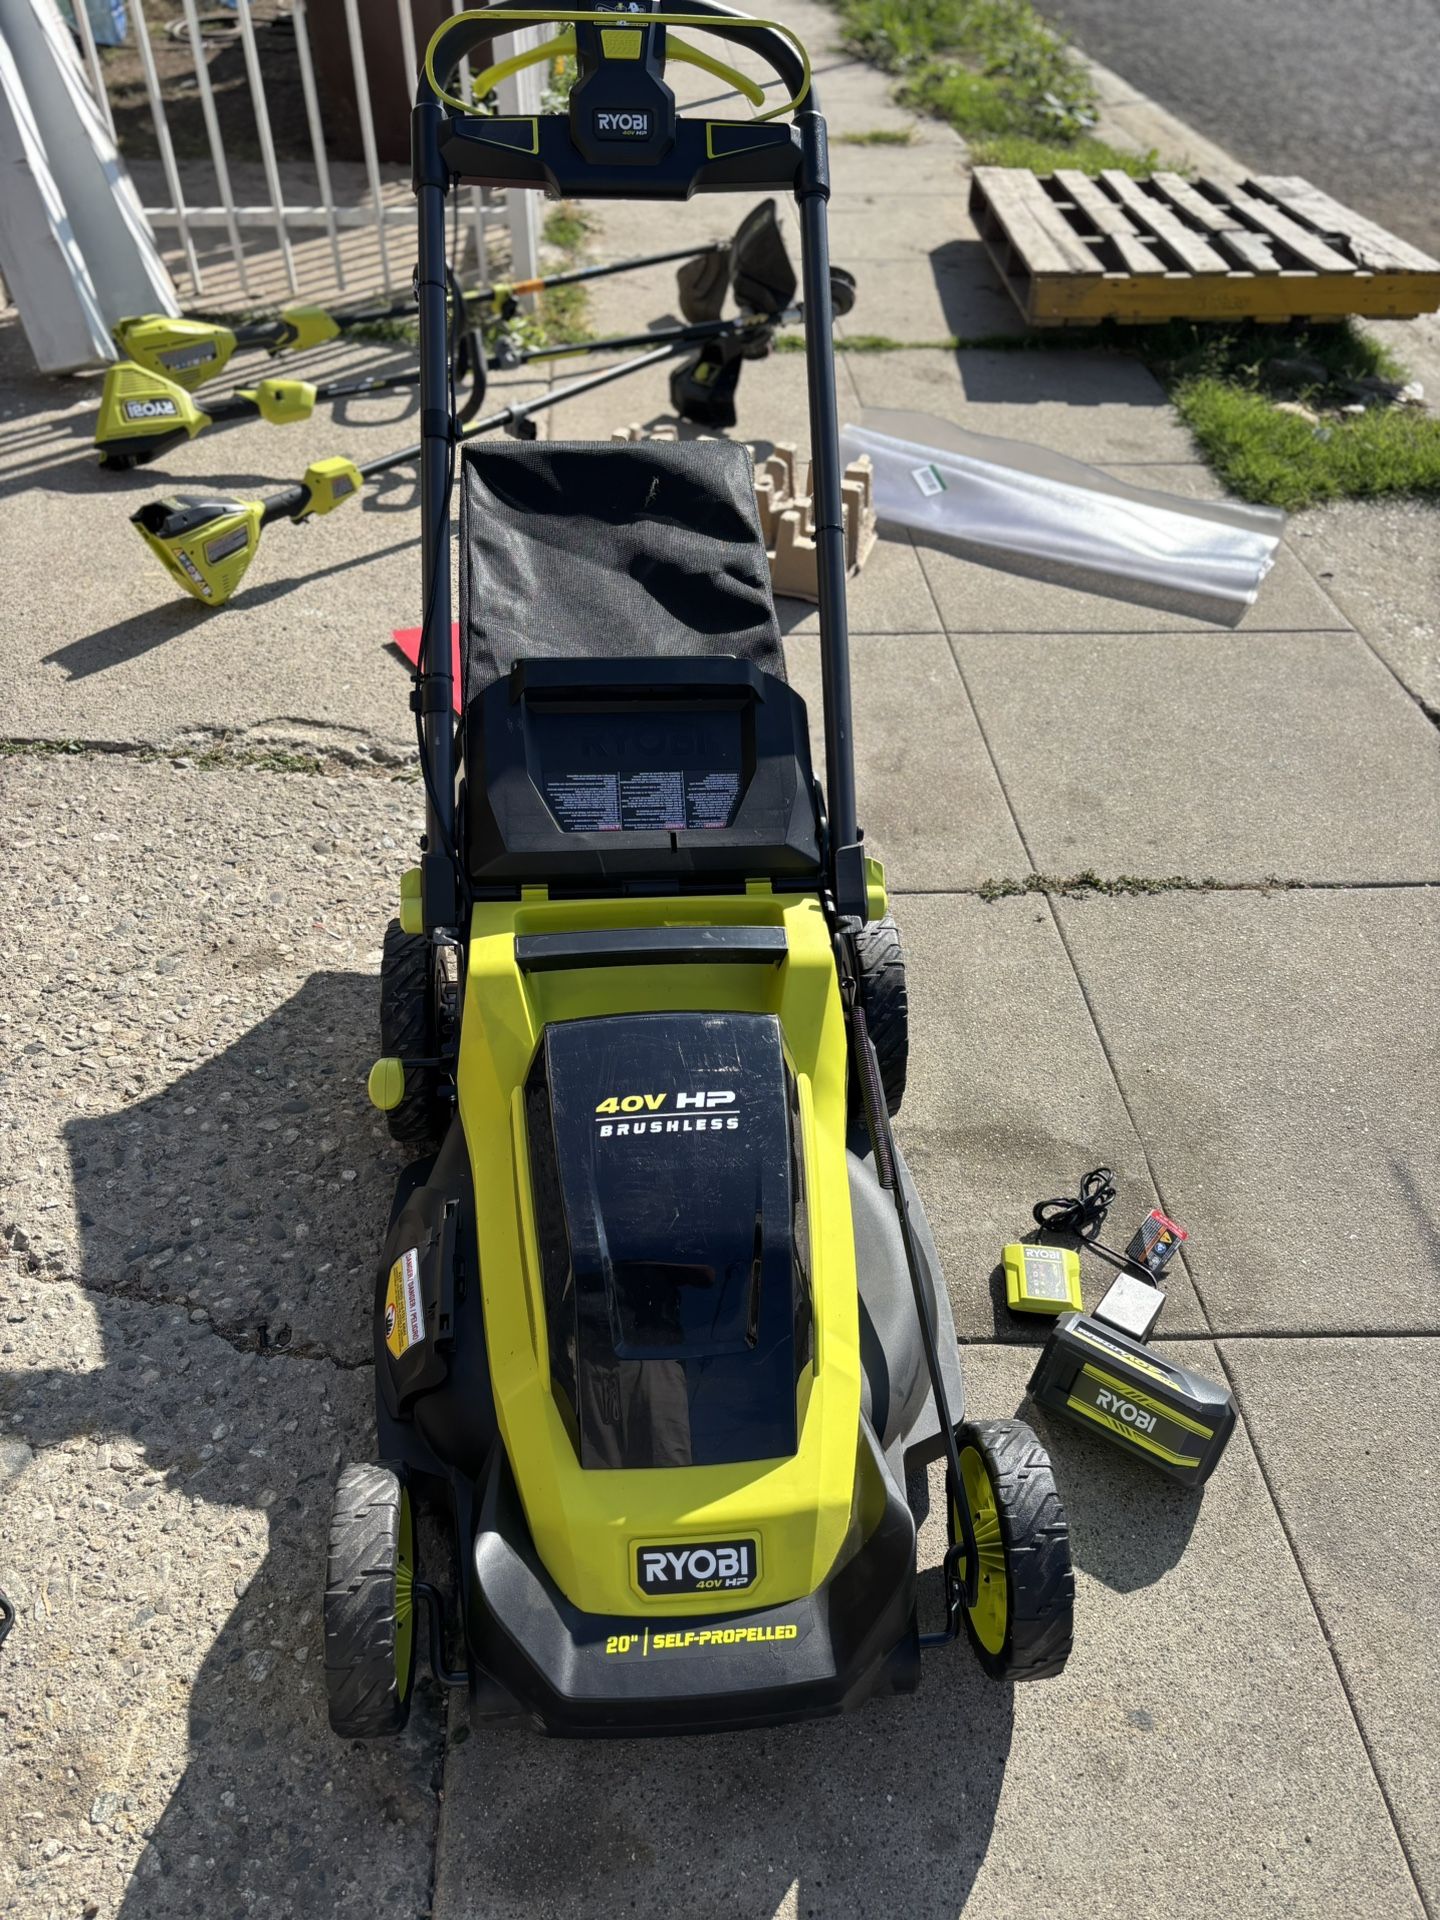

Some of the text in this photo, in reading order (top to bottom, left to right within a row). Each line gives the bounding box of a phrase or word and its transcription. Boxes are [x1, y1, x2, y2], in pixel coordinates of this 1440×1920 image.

[598, 113, 648, 130] RYOBI
[126, 401, 177, 418] RYOBI
[595, 1090, 736, 1114] 40V HP
[600, 1118, 739, 1137] BRUSHLESS
[405, 1253, 413, 1278] DANGER
[1025, 1248, 1060, 1260] RYOBI
[408, 1281, 416, 1308] DANGER
[411, 1312, 420, 1340] PELIGRO
[1095, 1388, 1157, 1434] RYOBI
[643, 1546, 749, 1583] RYOBI
[695, 1577, 748, 1589] 40V HP
[606, 1624, 798, 1655] 20" SELF-PROPELLED
